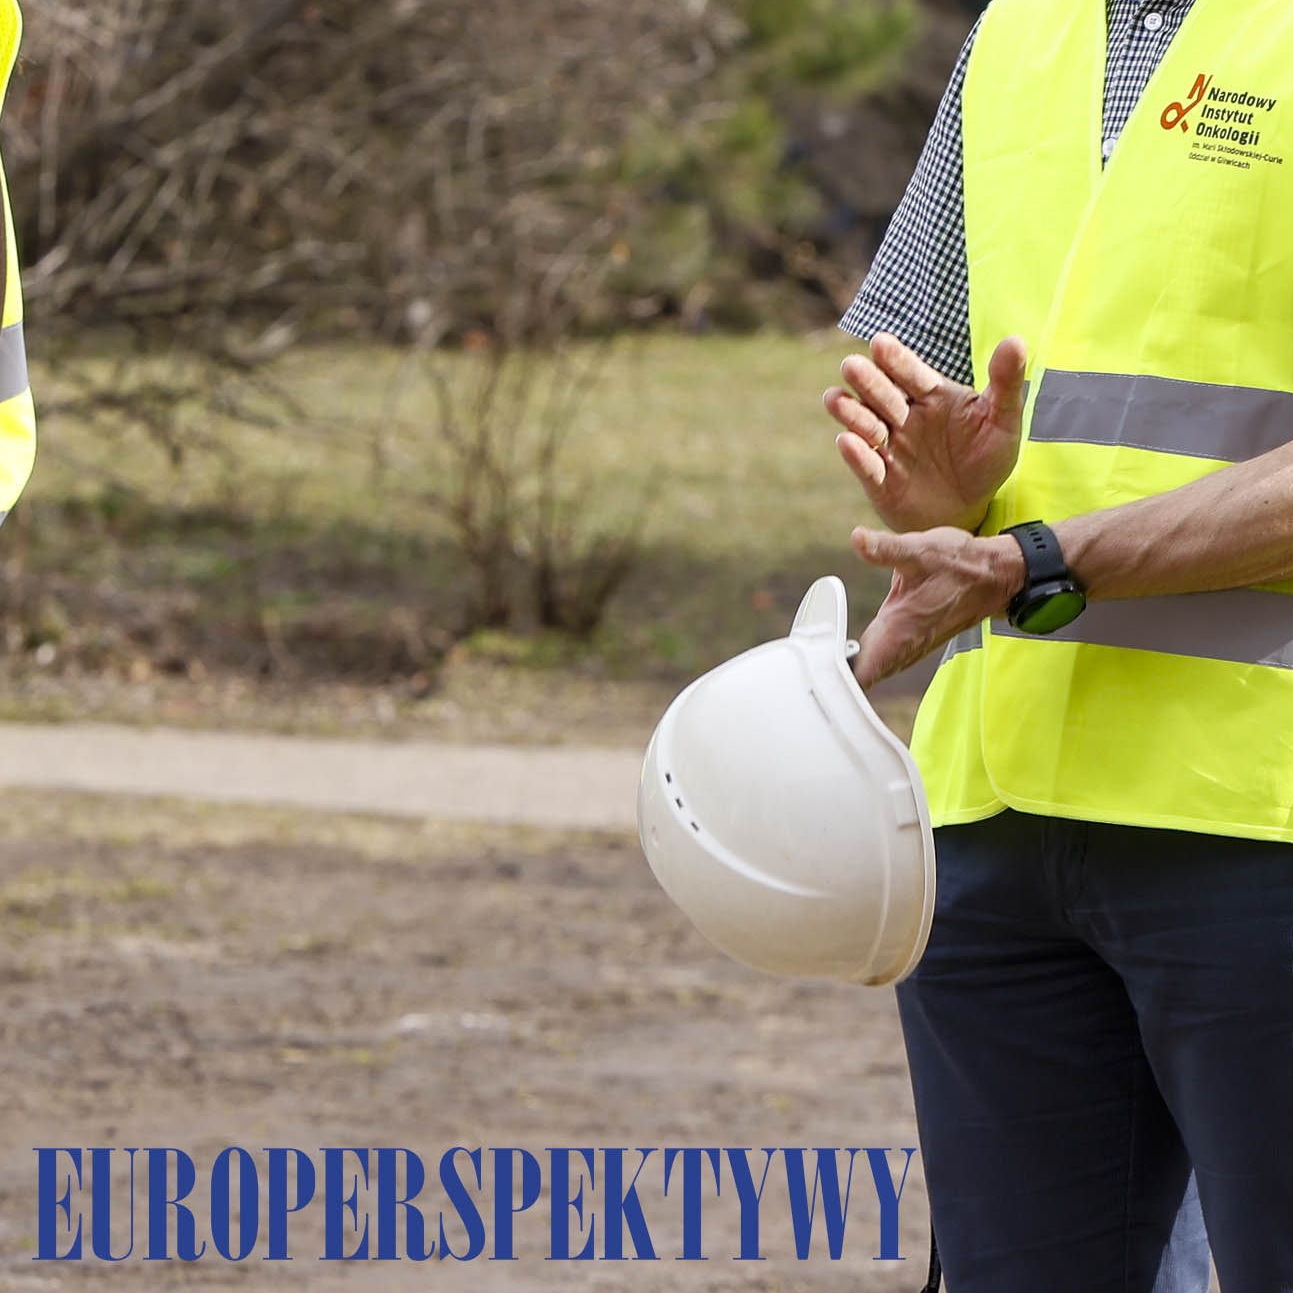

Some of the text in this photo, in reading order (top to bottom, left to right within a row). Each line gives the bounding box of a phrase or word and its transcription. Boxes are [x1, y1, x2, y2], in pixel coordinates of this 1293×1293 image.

[1208, 88, 1276, 112] Narodowy
[1201, 104, 1254, 125] Instytut
[1196, 122, 1260, 146] Onkologii
